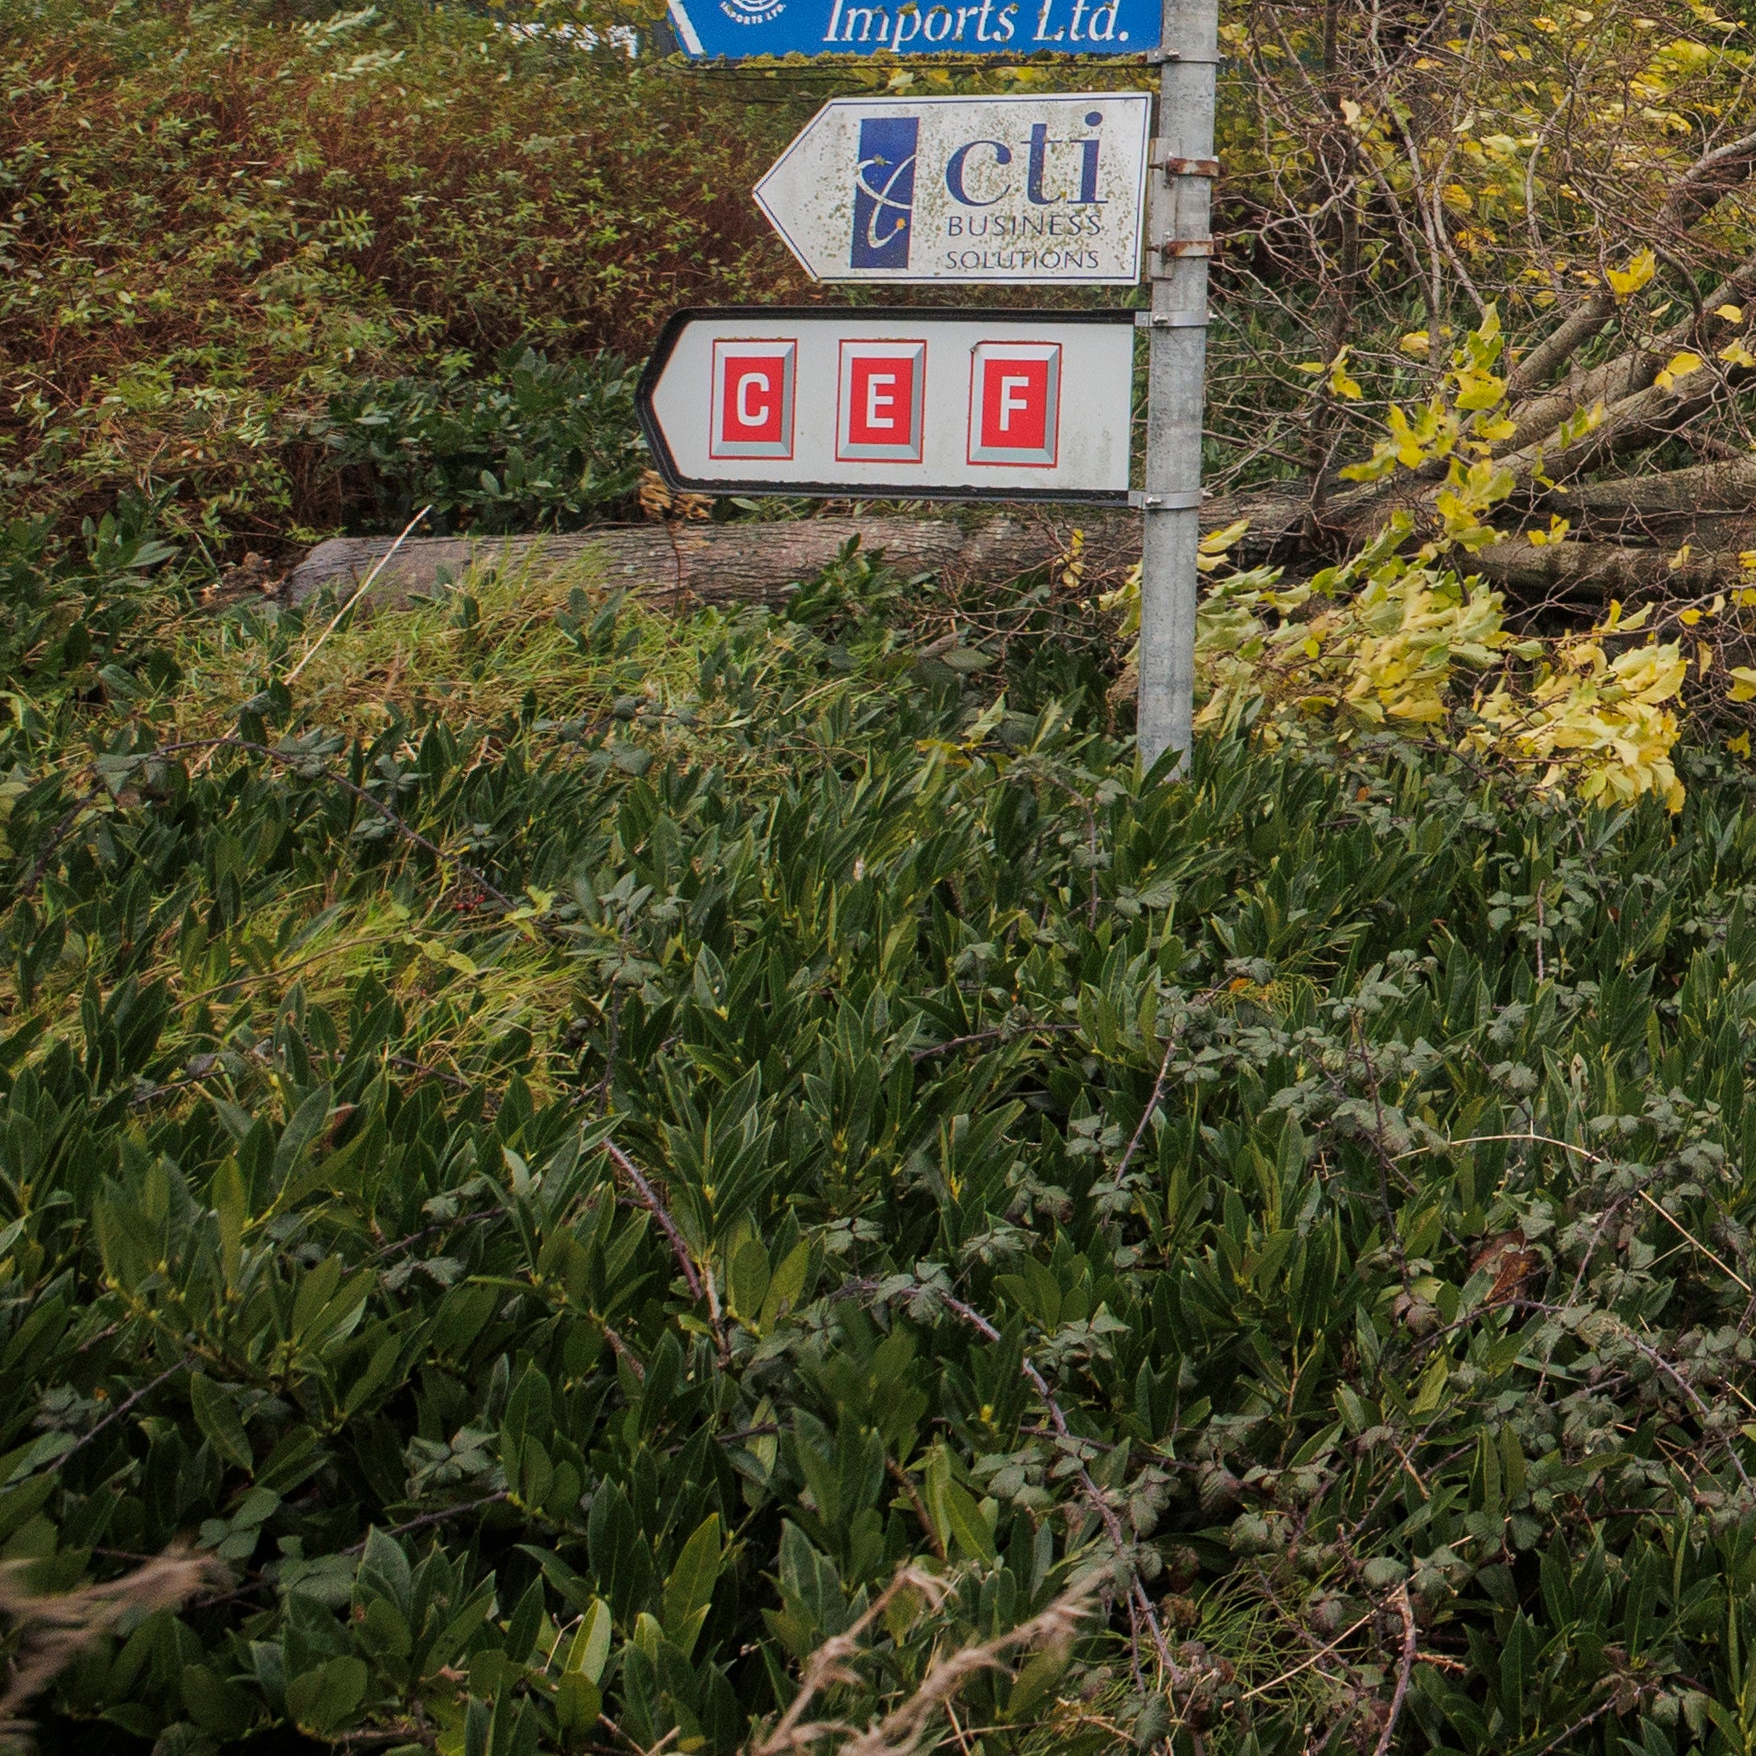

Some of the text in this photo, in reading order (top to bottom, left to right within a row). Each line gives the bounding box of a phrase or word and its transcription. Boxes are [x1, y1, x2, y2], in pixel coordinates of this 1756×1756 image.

[946, 111, 1108, 206] cti
[948, 215, 1101, 237] BUSINESS
[946, 251, 1099, 269] SOLUTIONS
[736, 372, 1029, 432] C E F
